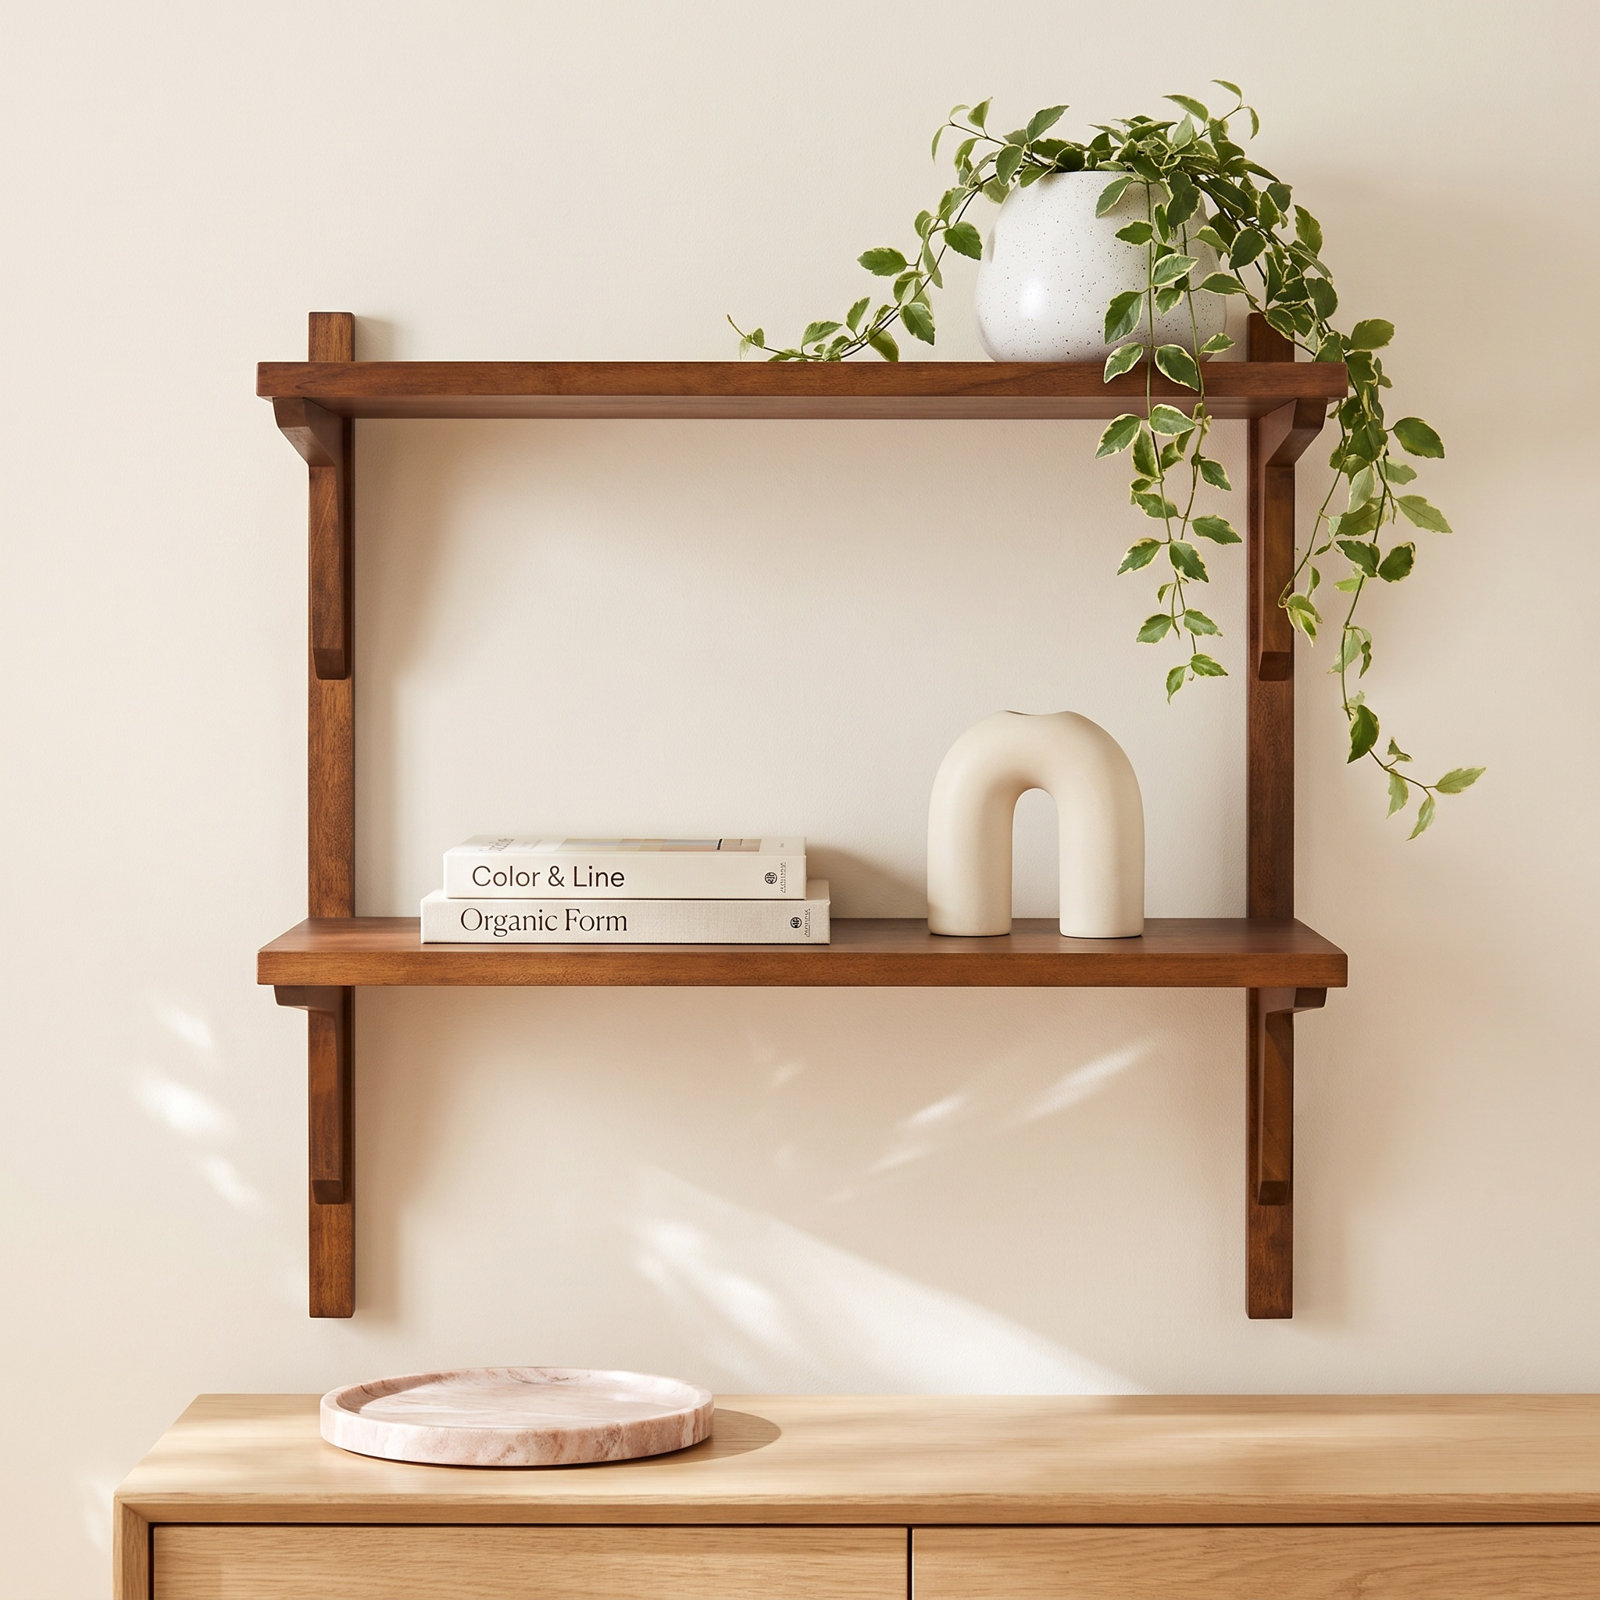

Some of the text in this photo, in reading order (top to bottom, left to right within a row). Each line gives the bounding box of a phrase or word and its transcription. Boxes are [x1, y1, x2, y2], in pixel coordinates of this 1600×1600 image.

[472, 865, 625, 887] Color & Line
[461, 908, 628, 937] Organic Form
